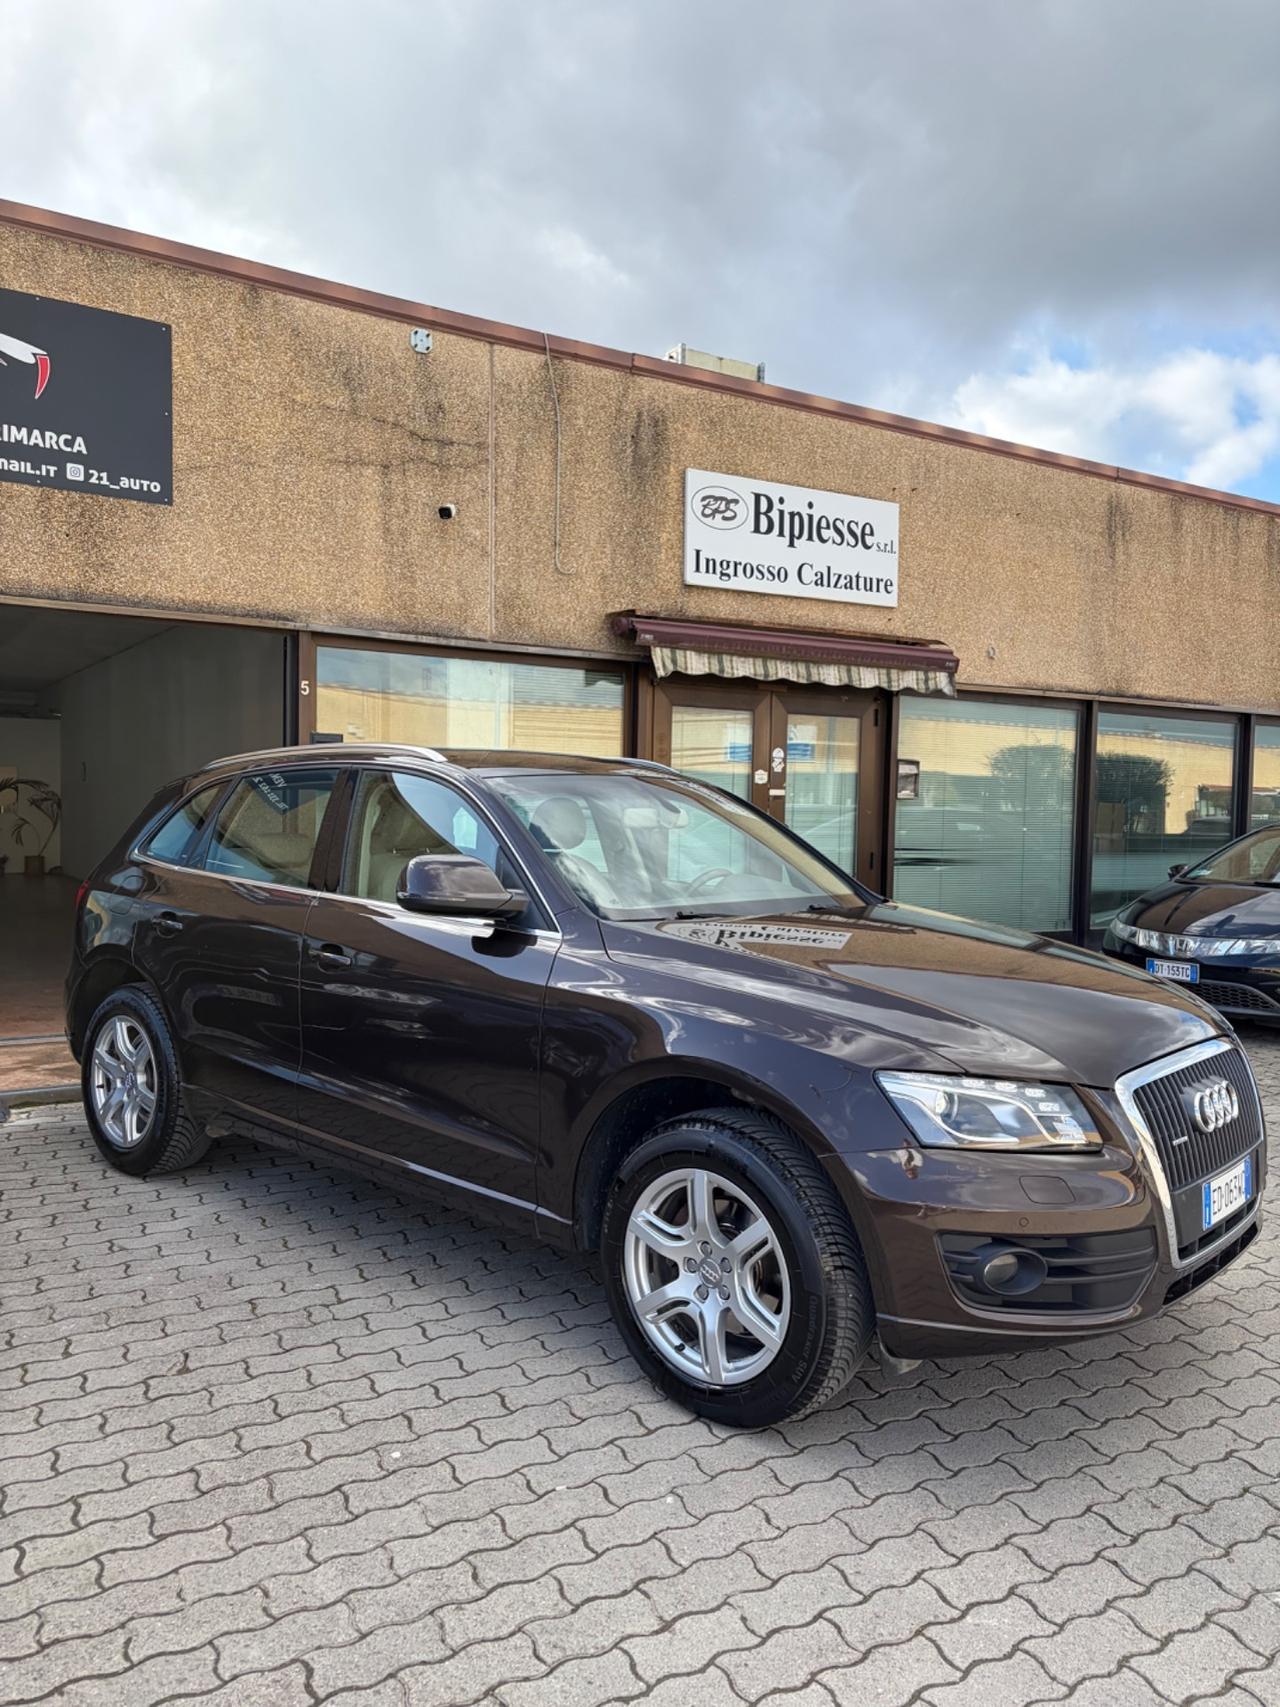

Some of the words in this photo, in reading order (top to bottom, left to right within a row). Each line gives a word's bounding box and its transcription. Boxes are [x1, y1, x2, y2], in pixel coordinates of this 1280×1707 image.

[0, 424, 88, 454] IMARCA
[750, 491, 875, 550] Bipiesse
[876, 540, 897, 554] s.r.l.
[693, 548, 789, 582] Ingrosso
[797, 562, 894, 595] Calzature
[300, 680, 310, 696] 5
